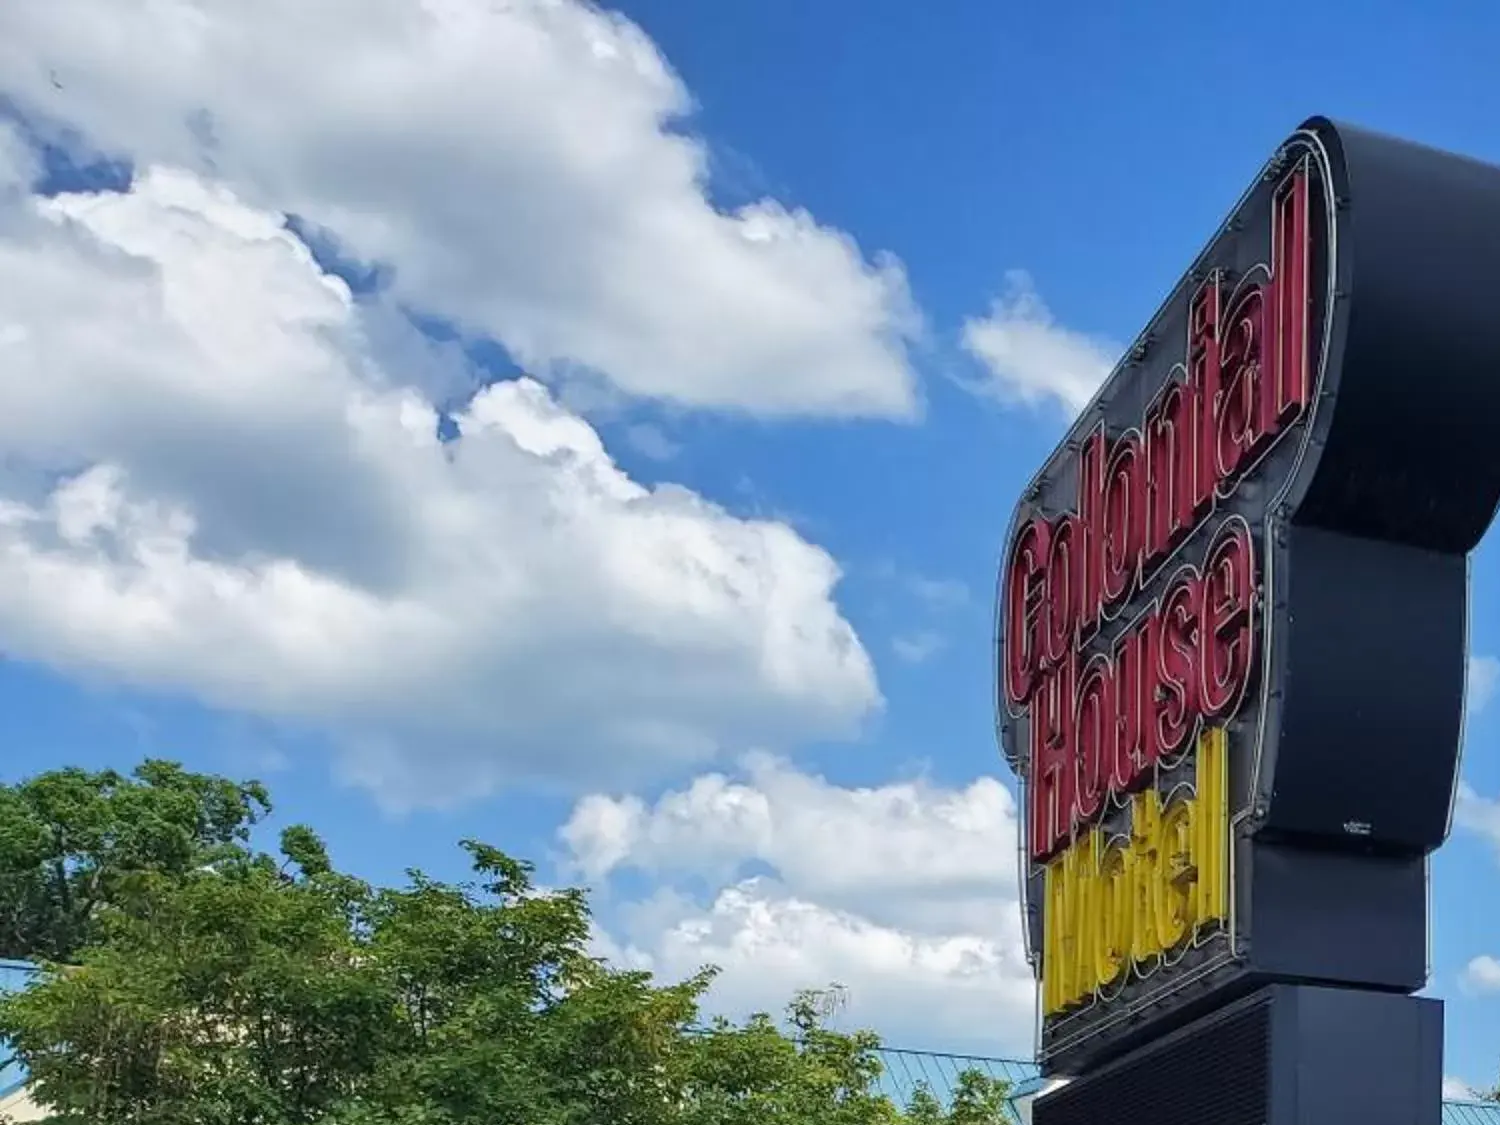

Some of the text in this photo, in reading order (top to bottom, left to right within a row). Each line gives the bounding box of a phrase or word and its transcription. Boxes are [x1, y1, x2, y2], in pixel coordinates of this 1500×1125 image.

[1004, 162, 1310, 702] Colonial
[1029, 517, 1253, 862] House
[1042, 725, 1229, 1017] Motel
